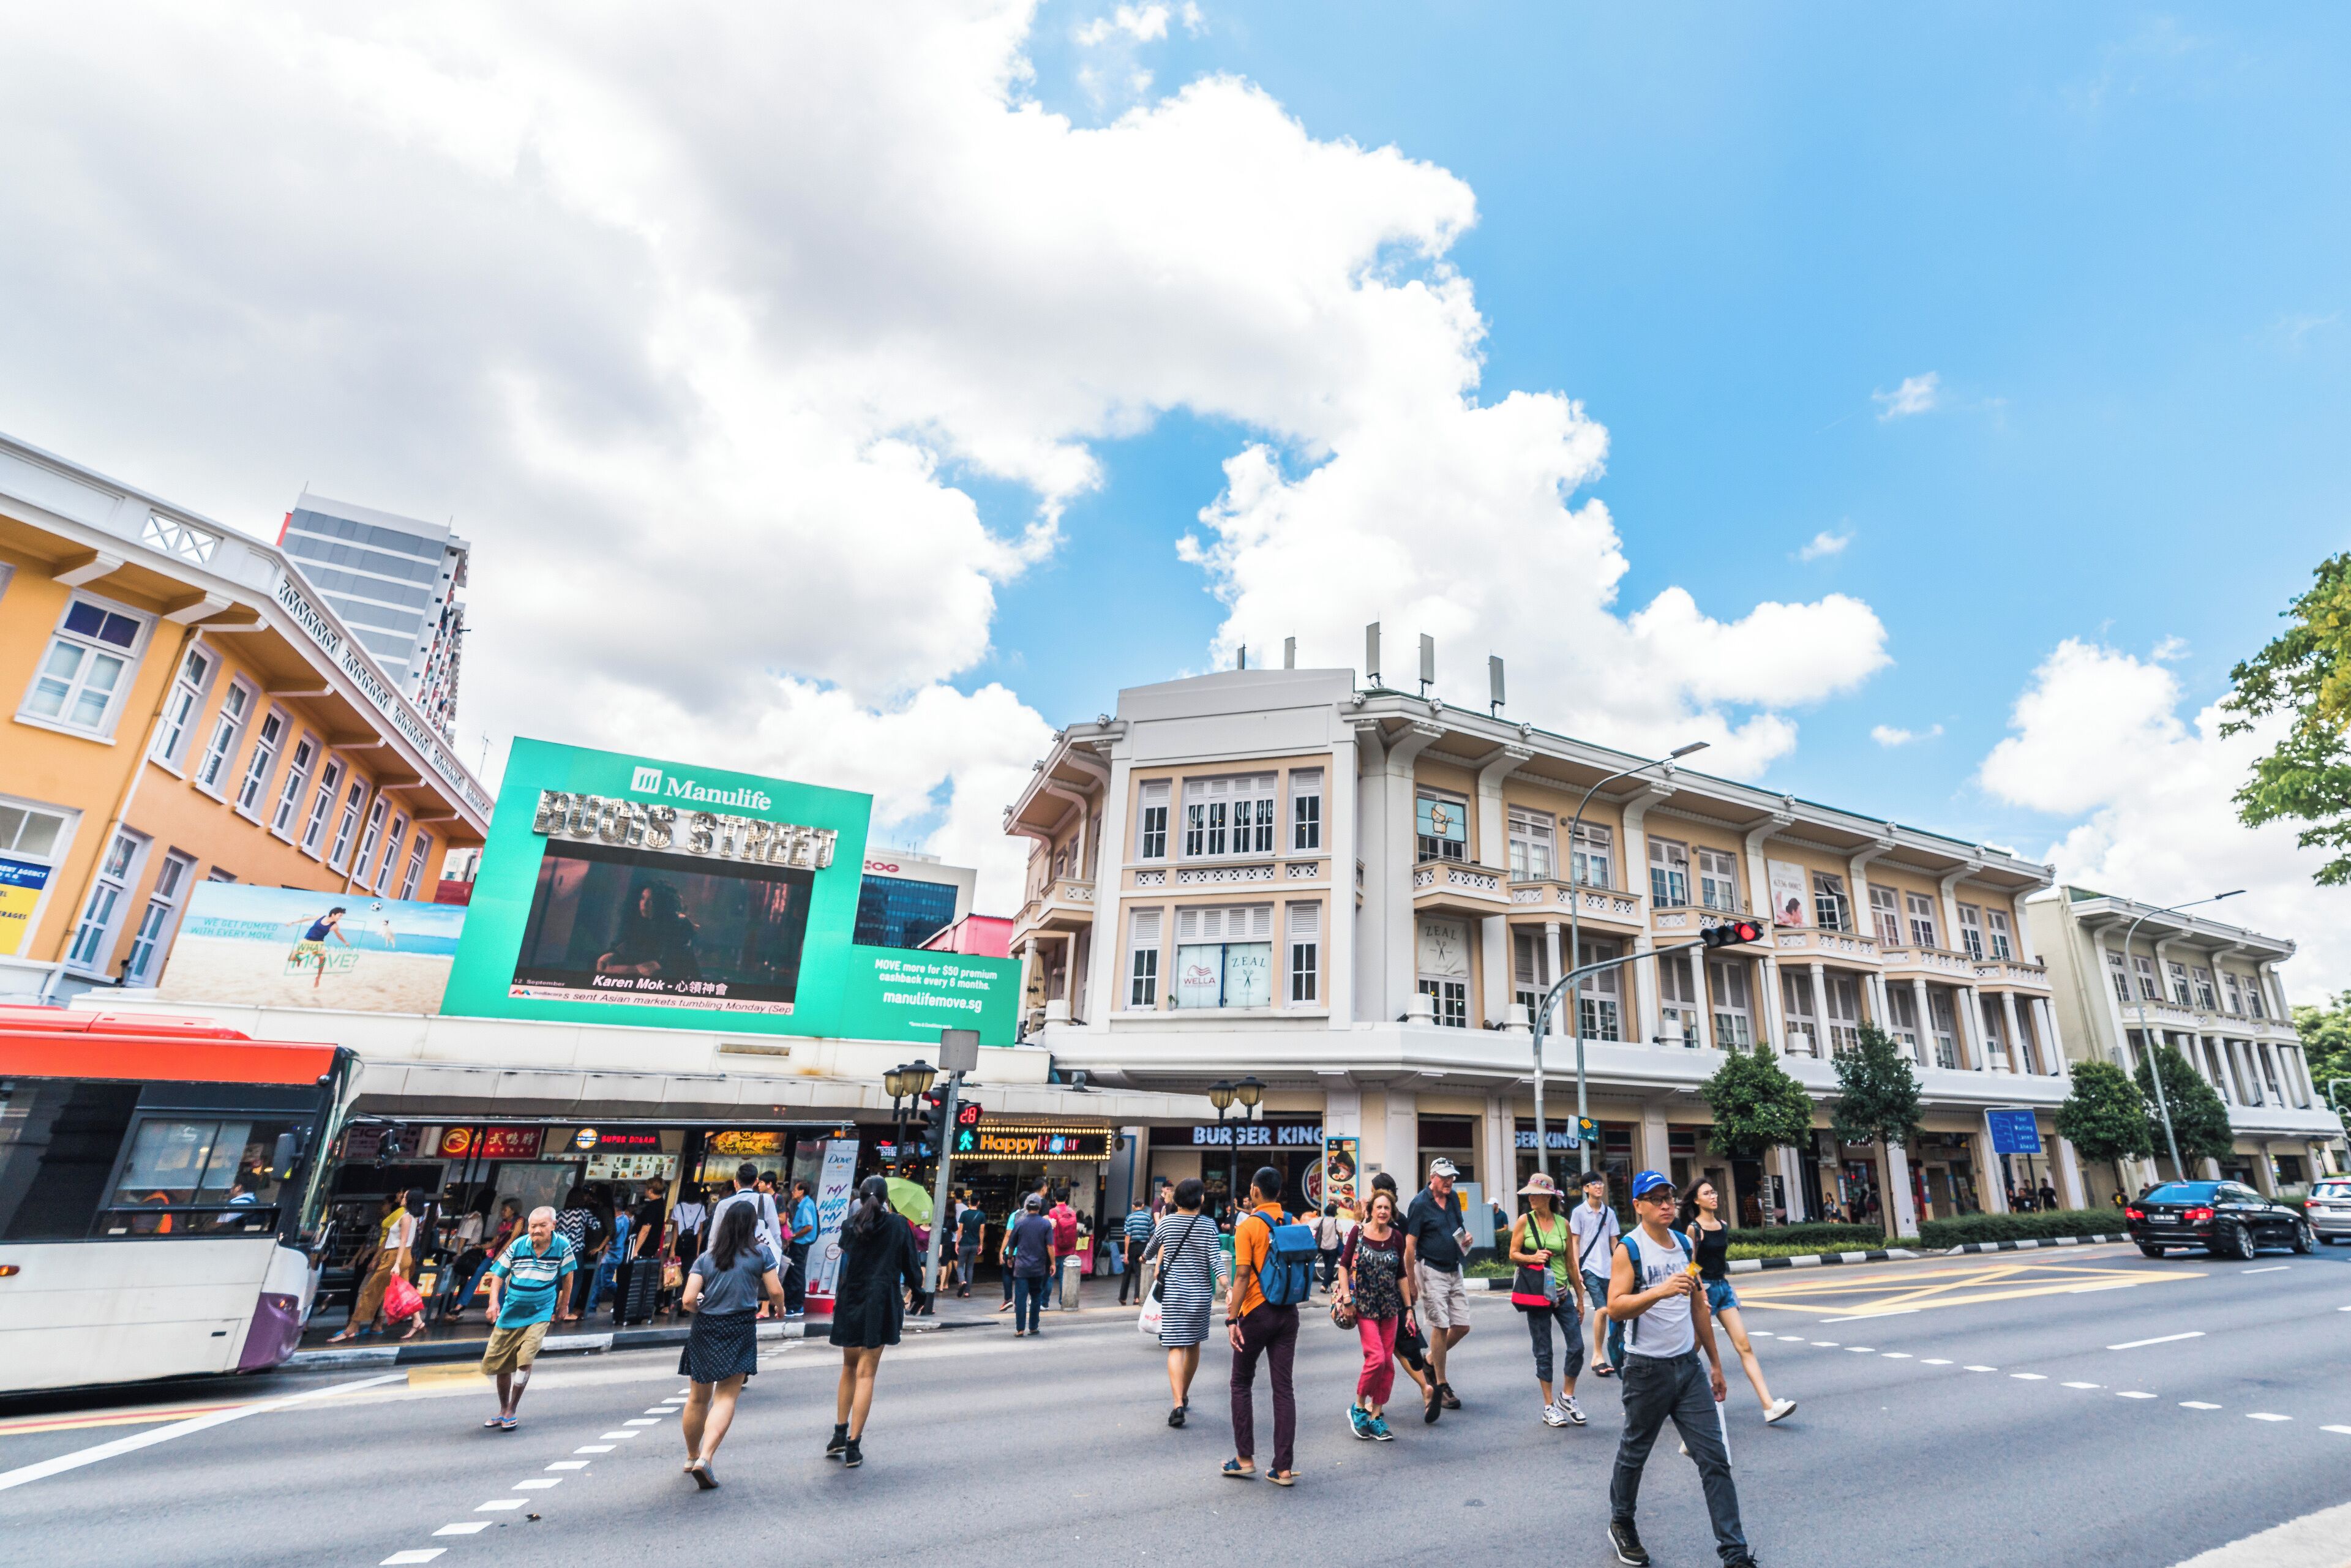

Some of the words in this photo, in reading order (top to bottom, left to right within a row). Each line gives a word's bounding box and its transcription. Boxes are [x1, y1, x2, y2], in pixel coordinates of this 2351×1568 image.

[664, 776, 772, 811] Manulife
[533, 789, 677, 849] BUGIS
[686, 811, 838, 869] STREET
[17, 868, 47, 878] AGENCY
[204, 918, 218, 927] WE
[222, 920, 238, 929] GET
[241, 921, 278, 931] PUMPED
[1425, 925, 1457, 940] ZEAL
[190, 927, 214, 936] WITH
[217, 928, 246, 938] EVERY
[249, 930, 274, 939] MOVE
[291, 953, 360, 969] MOVE?
[1231, 956, 1266, 968] ZEAL
[875, 959, 902, 970] MOVE
[902, 964, 926, 973] more
[928, 964, 941, 975] for
[942, 965, 959, 977] $50
[960, 969, 997, 980] premium
[592, 975, 633, 988] Karen
[636, 978, 666, 991] Mok
[879, 972, 922, 985] cashback
[924, 977, 948, 989] every
[950, 977, 956, 987] 6
[957, 978, 990, 990] months.
[573, 993, 598, 1002] sent
[599, 994, 631, 1003] Asian
[633, 996, 677, 1007] markets
[678, 999, 723, 1011] tumbling
[726, 1002, 767, 1014] Monday
[768, 1005, 792, 1015] (Sep
[883, 991, 983, 1013] manulifemove.sg
[601, 1135, 626, 1144] SUPER
[628, 1135, 656, 1144] DREAM
[1193, 1125, 1272, 1146] BURGER
[1277, 1125, 1323, 1145] KING
[828, 1153, 852, 1164] Dove
